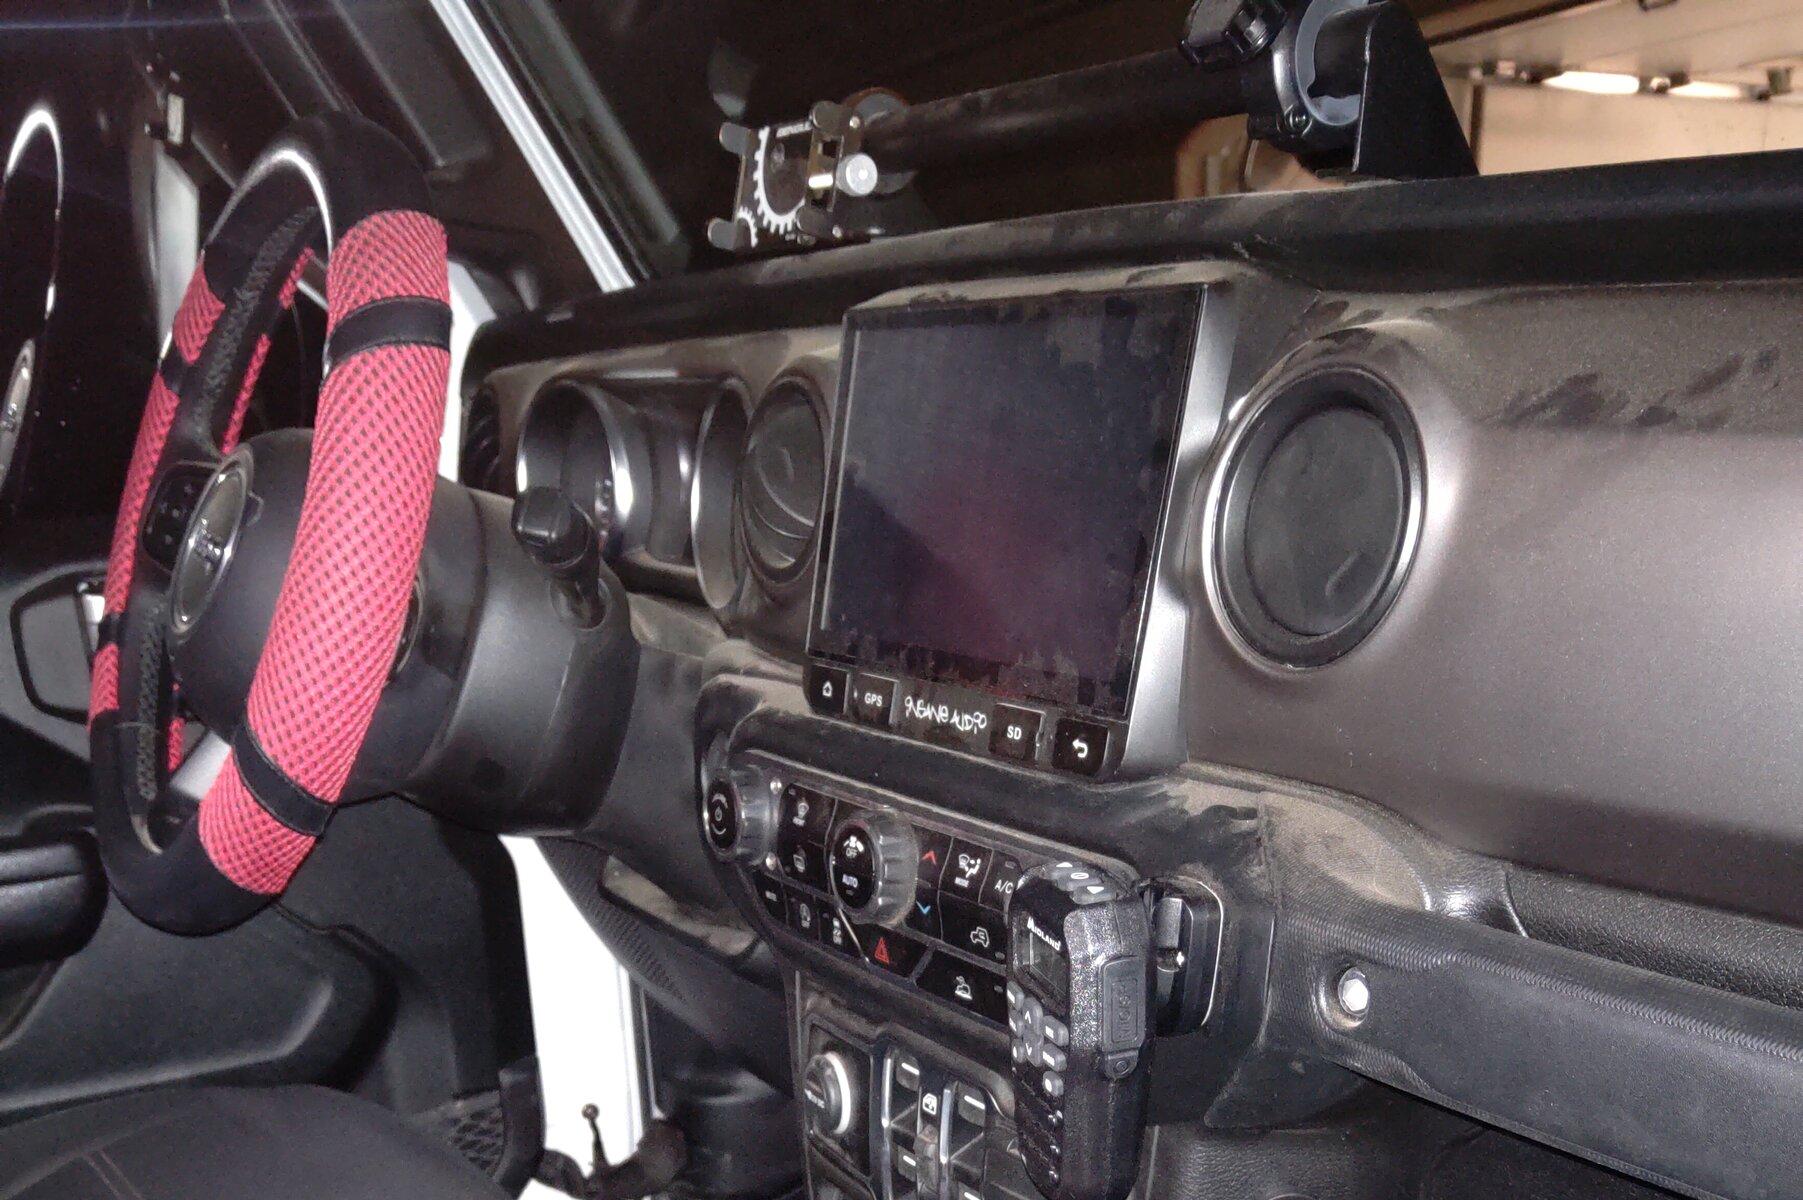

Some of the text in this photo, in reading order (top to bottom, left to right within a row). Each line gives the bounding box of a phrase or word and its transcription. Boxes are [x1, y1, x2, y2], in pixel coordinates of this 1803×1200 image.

[864, 692, 883, 707] GPS
[1006, 726, 1022, 740] SD
[842, 873, 858, 888] AUTO
[994, 879, 1014, 894] A/C
[1027, 916, 1062, 951] MIDLAND
